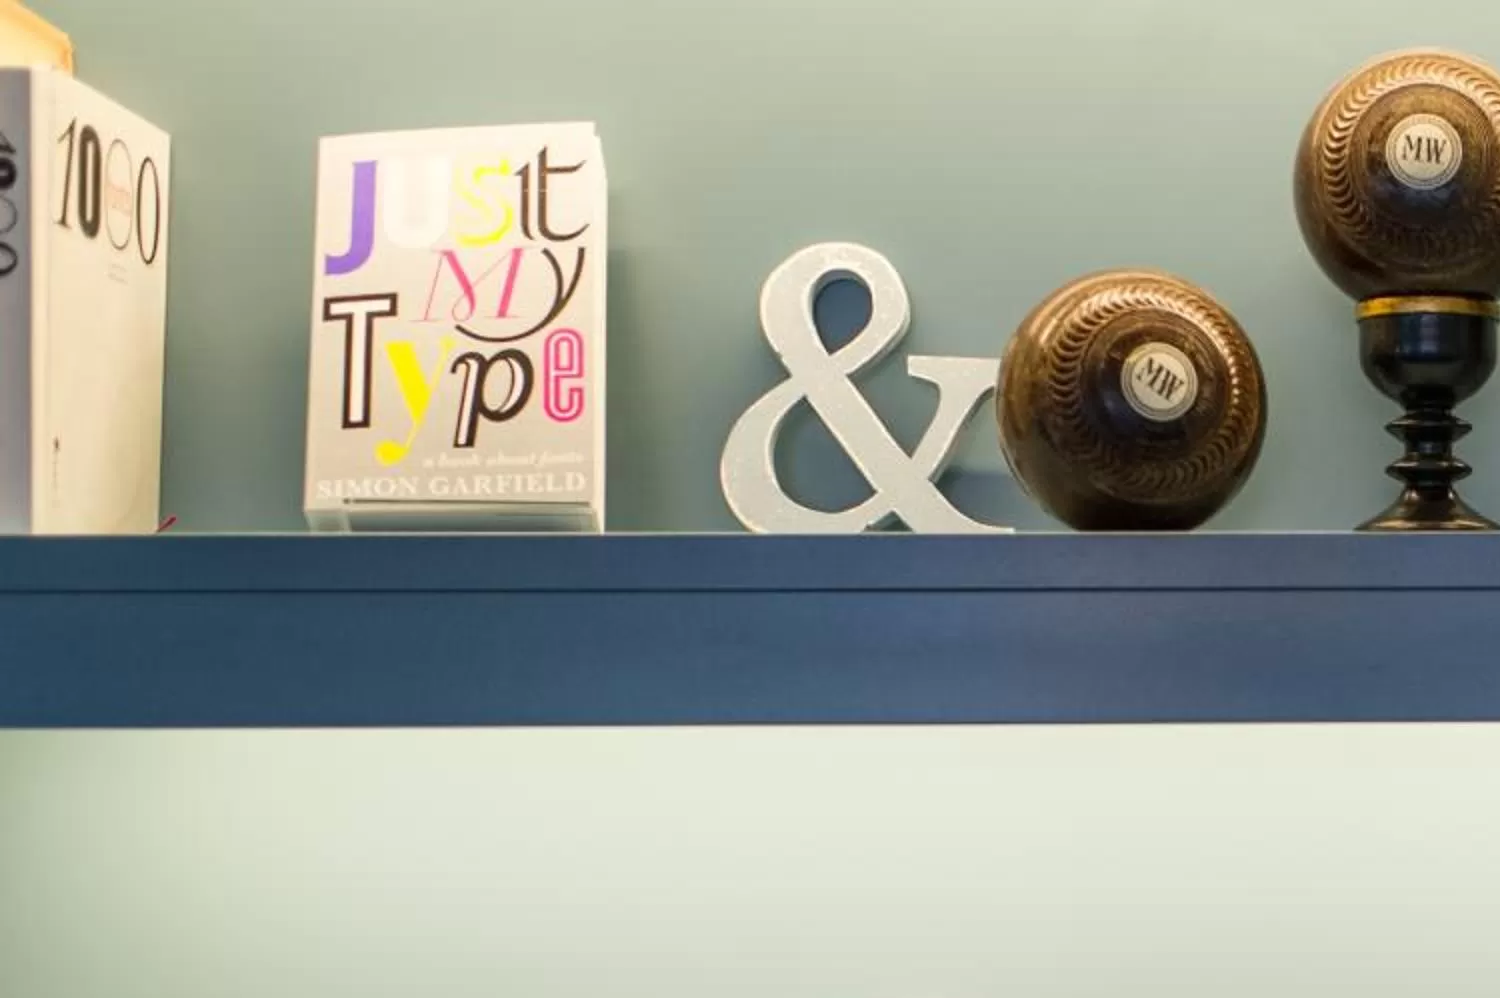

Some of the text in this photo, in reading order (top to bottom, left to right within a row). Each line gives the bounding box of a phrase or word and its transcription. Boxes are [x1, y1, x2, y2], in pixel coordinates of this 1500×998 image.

[1402, 135, 1447, 165] MW
[53, 116, 161, 265] 1000
[408, 246, 586, 343] My
[322, 292, 586, 468] Type
[1136, 357, 1185, 400] MW
[316, 471, 588, 499] SIMON GARFIELD
